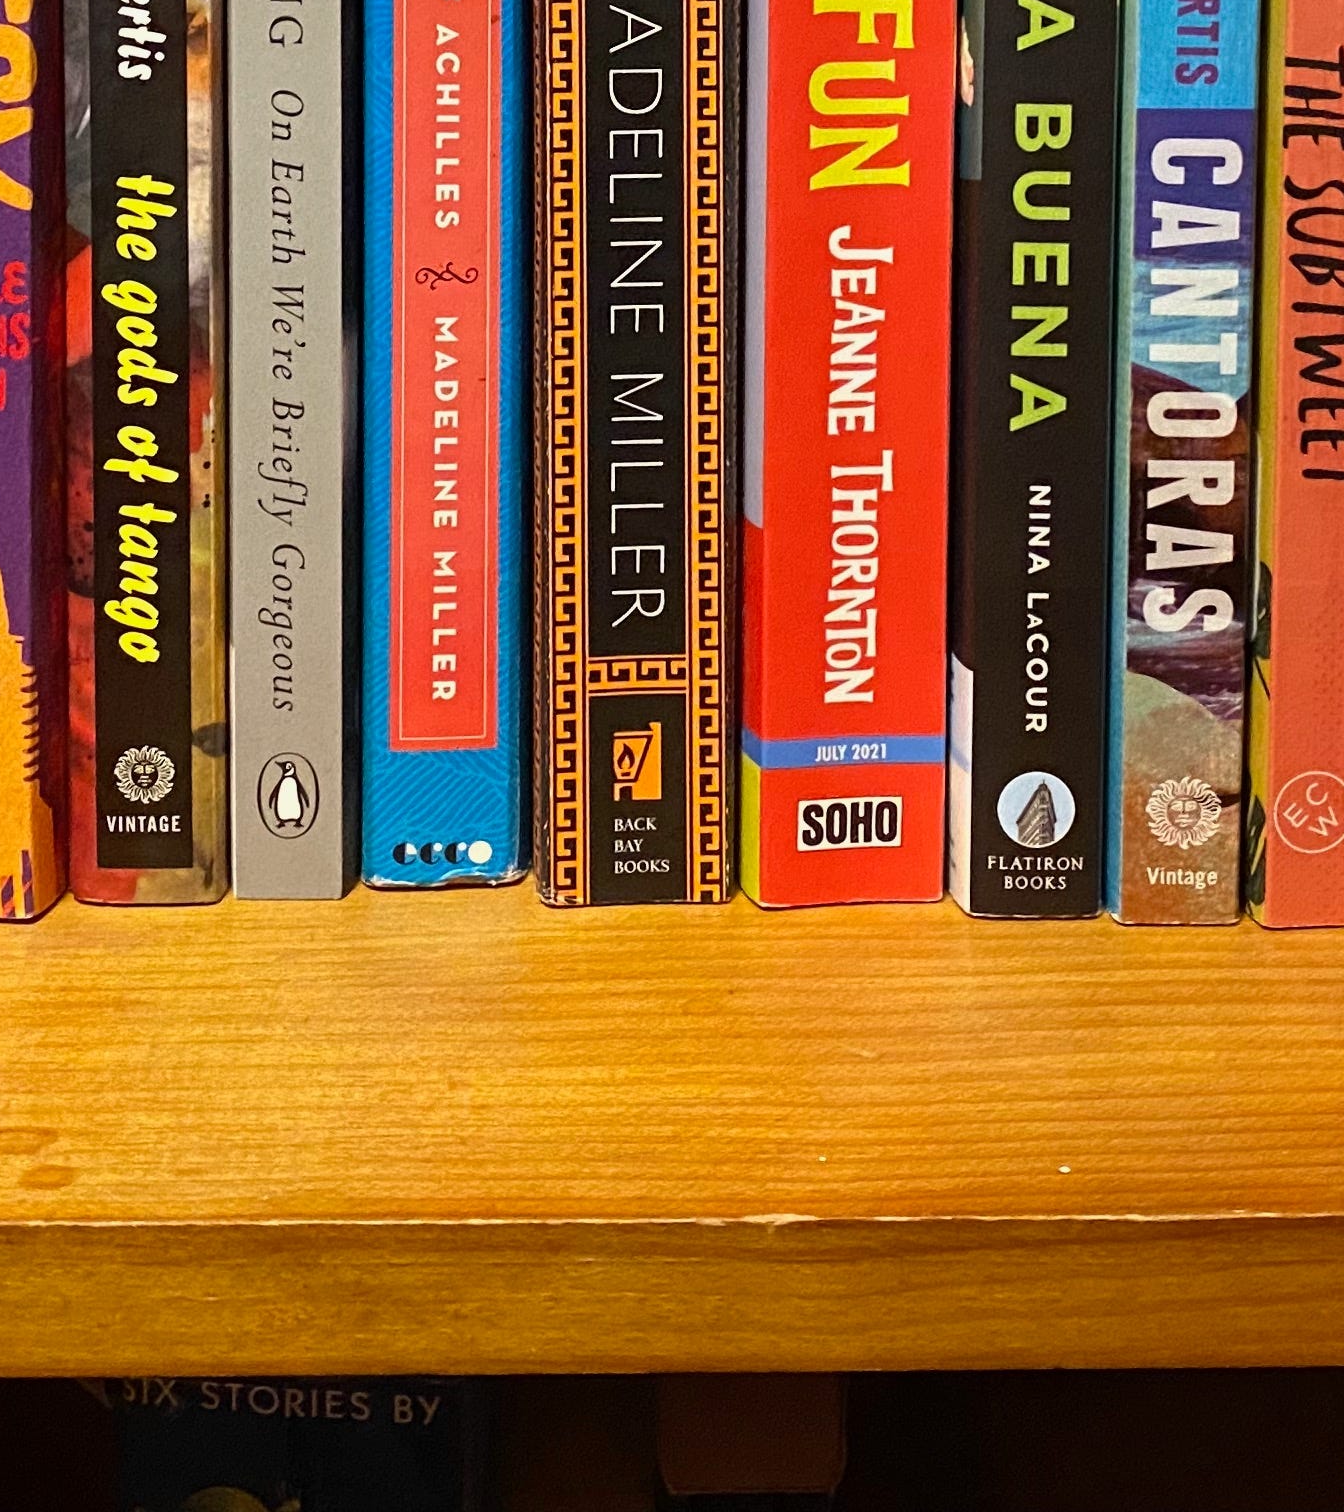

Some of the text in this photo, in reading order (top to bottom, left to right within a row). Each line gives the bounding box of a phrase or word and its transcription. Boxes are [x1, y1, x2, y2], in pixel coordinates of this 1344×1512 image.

[434, 23, 462, 229] ACHILLES
[1009, 103, 1073, 432] BUENA
[102, 174, 180, 664] the gods of tango
[255, 88, 308, 713] On Earth Briefly Gorgeous
[1143, 138, 1244, 633] CANTORAS
[823, 225, 895, 704] JEANNE THORNTON
[431, 316, 461, 702] MADELINE MILLER
[609, 371, 665, 629] MILLER
[1027, 485, 1052, 575] NINA
[814, 741, 888, 763] JULY 2021
[105, 813, 182, 834] VINTAGE
[613, 817, 657, 832] BACK
[613, 839, 643, 853] BAY
[613, 858, 670, 875] BOOKS
[987, 856, 1084, 873] FLATIRON
[1004, 874, 1067, 890] BOOKS
[1146, 867, 1218, 888] Vintage
[200, 1381, 372, 1421] STORIES
[392, 1394, 441, 1425] BY
